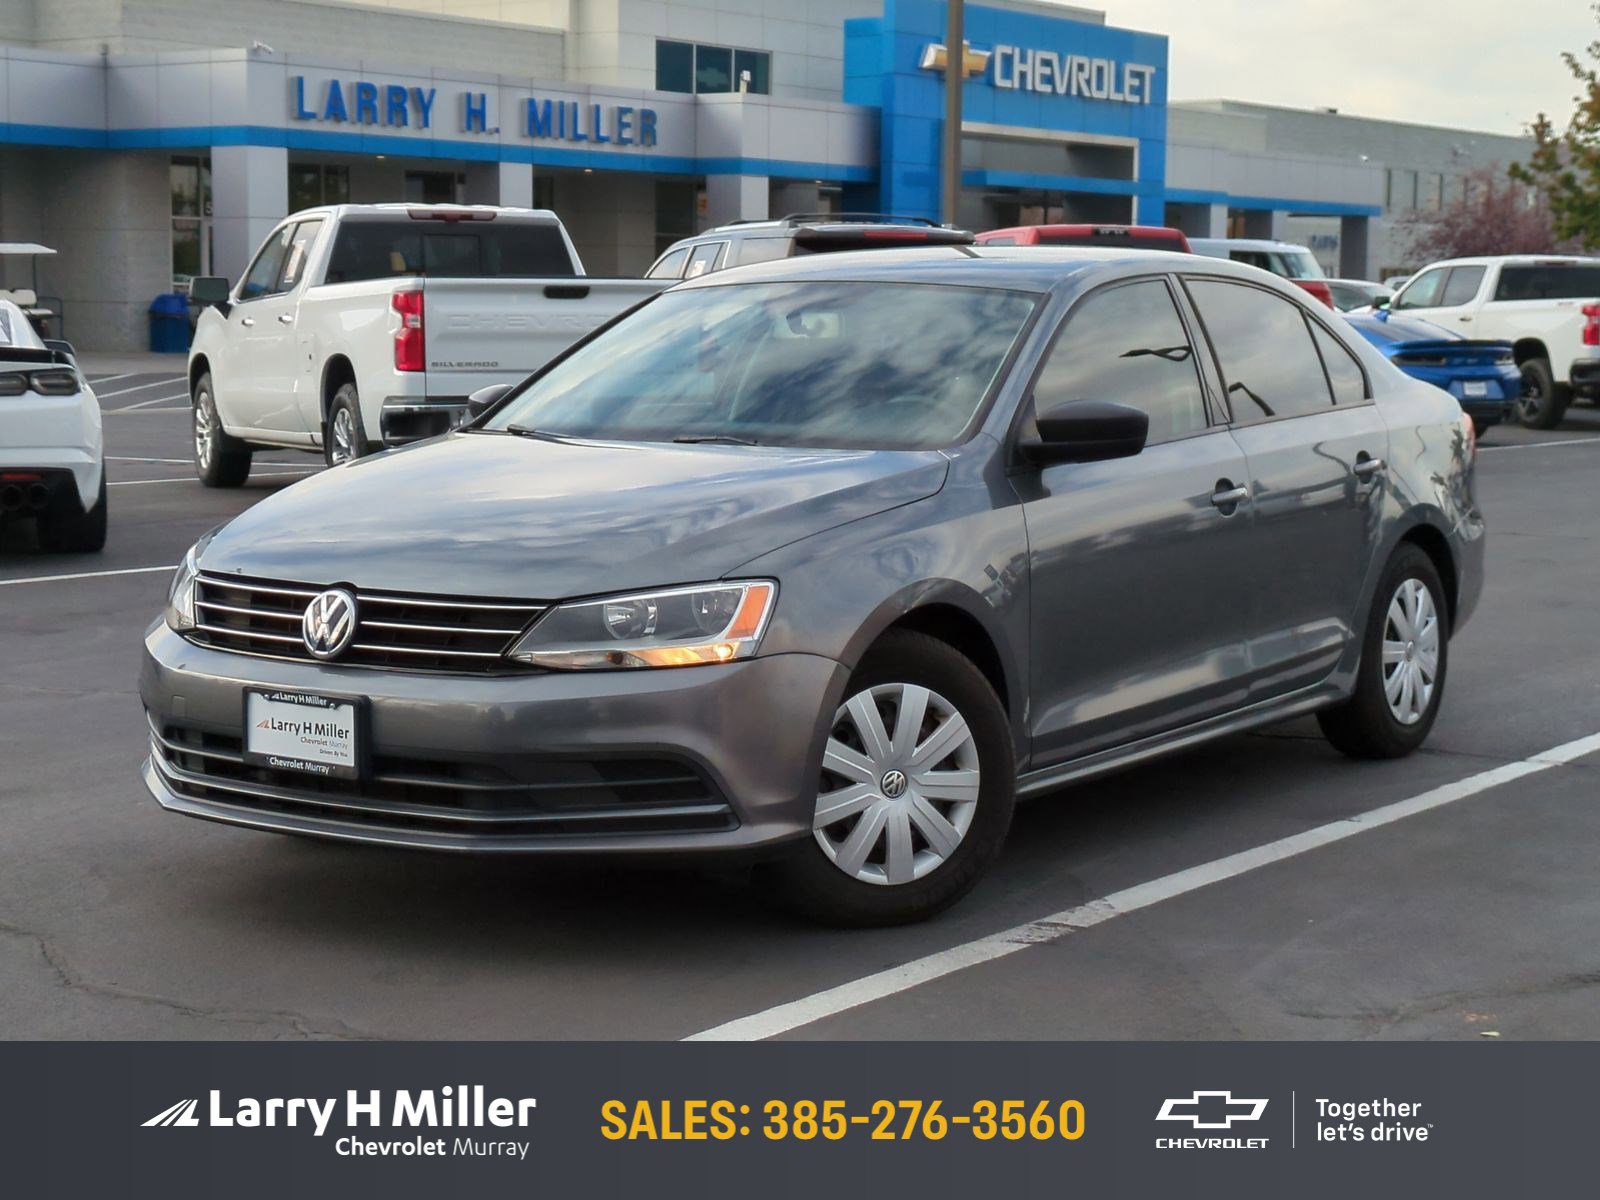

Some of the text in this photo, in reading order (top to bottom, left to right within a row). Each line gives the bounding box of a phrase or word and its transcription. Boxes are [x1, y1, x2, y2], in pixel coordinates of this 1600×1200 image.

[994, 44, 1156, 105] CHEVROLET
[294, 75, 658, 146] LARRY H. MILLER
[447, 313, 611, 330] CHEVRO
[280, 692, 327, 705] Larry H Miller
[271, 717, 350, 740] Larry H Miller
[301, 737, 328, 746] Chevrolet
[269, 756, 330, 775] Chevrolet Murray
